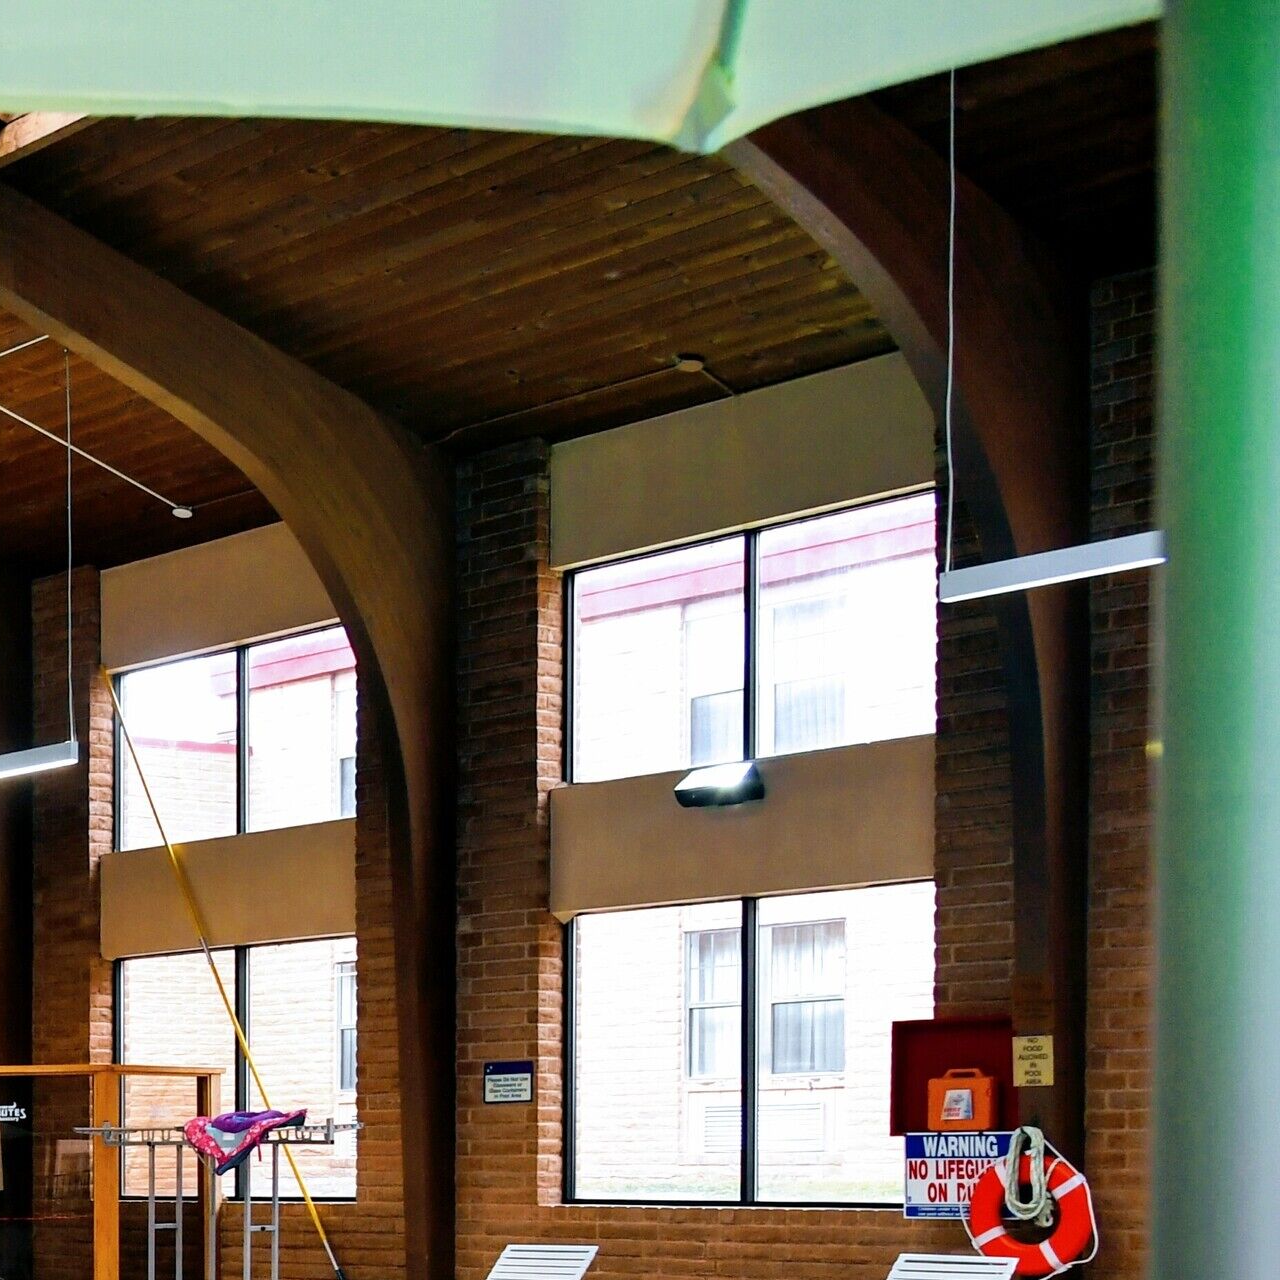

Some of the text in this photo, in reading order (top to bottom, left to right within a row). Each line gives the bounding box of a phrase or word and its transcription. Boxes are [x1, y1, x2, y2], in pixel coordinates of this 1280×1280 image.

[1018, 1053, 1049, 1061] ALLOWED
[923, 1136, 998, 1157] WARNING
[908, 1160, 928, 1179] NO
[927, 1183, 947, 1202] ON
